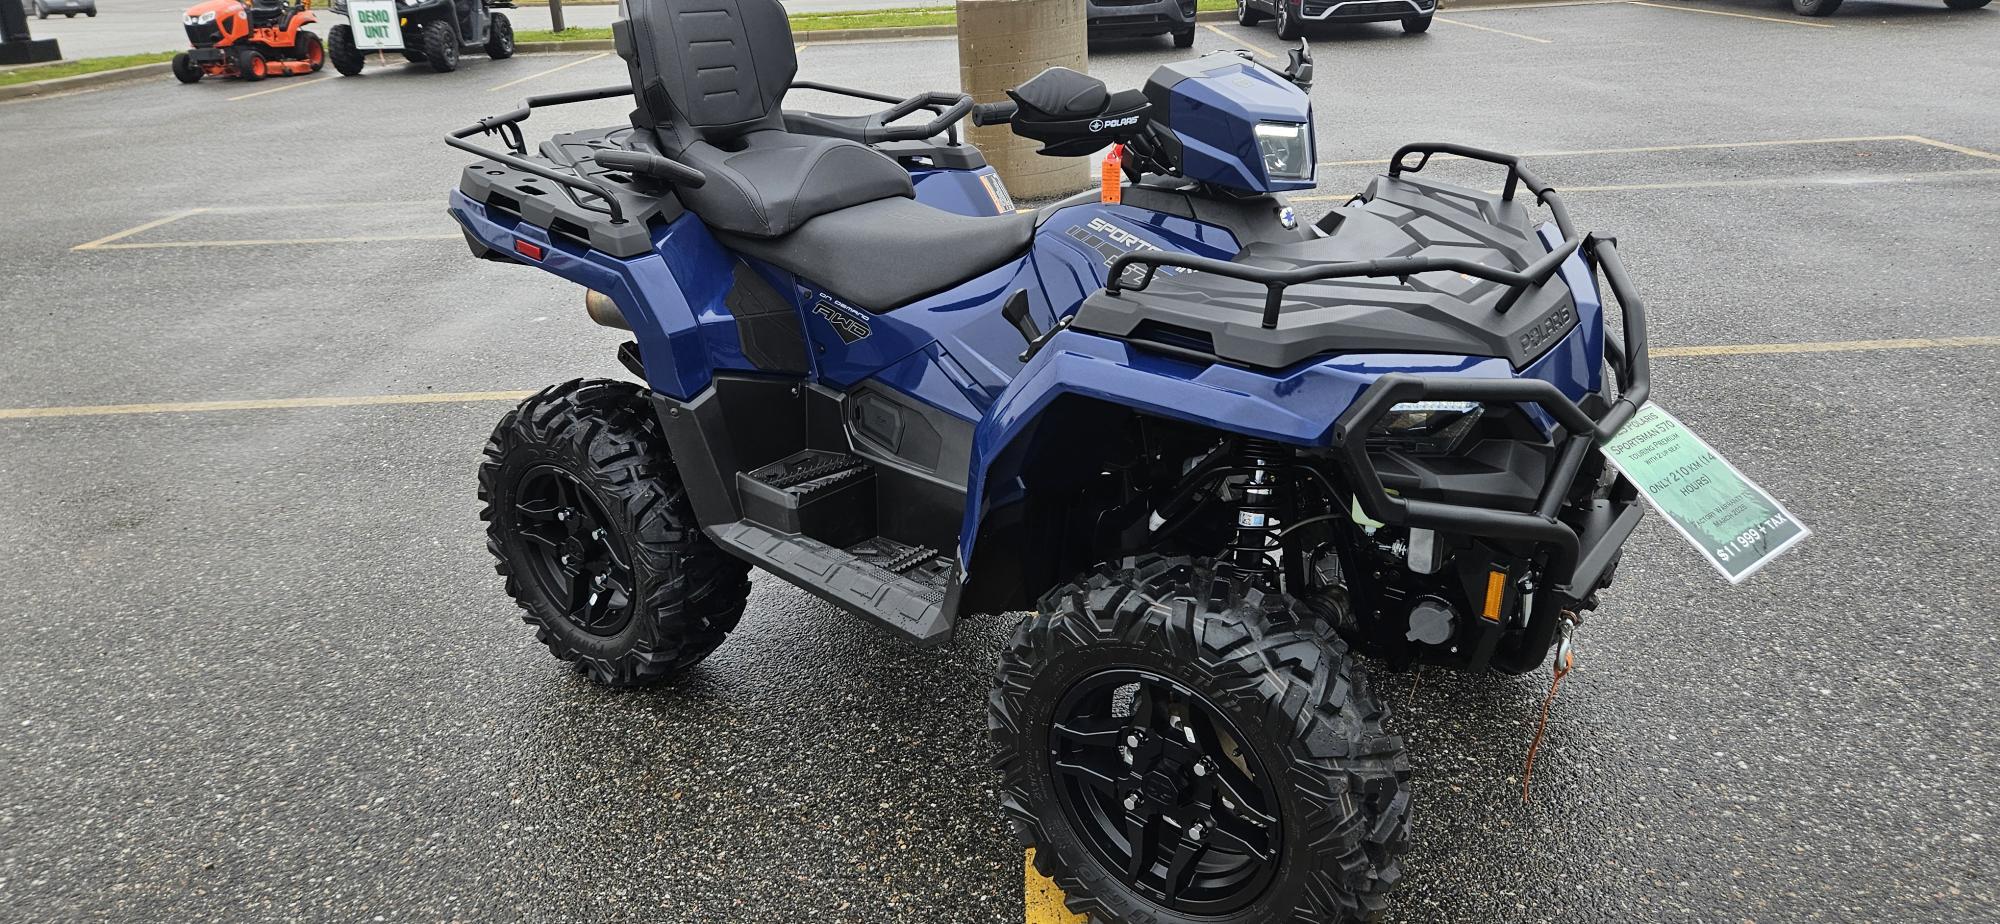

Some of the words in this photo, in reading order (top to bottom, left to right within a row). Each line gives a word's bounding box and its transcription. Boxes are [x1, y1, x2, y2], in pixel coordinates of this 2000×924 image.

[357, 9, 390, 23] DEMO
[364, 25, 389, 38] UNIT
[1104, 115, 1140, 128] POLARIS
[812, 303, 872, 339] AWD
[1520, 304, 1571, 357] POLARIS
[1627, 412, 1659, 431] POLARIS
[1610, 427, 1660, 455] SPORTSMAN
[1655, 420, 1675, 433] 570
[1649, 477, 1672, 494] ONLY
[1669, 466, 1690, 482] 210
[1687, 461, 1703, 472] KM
[1698, 452, 1717, 466] (14
[1680, 473, 1712, 497] HOURS)
[1764, 512, 1787, 530] TAX
